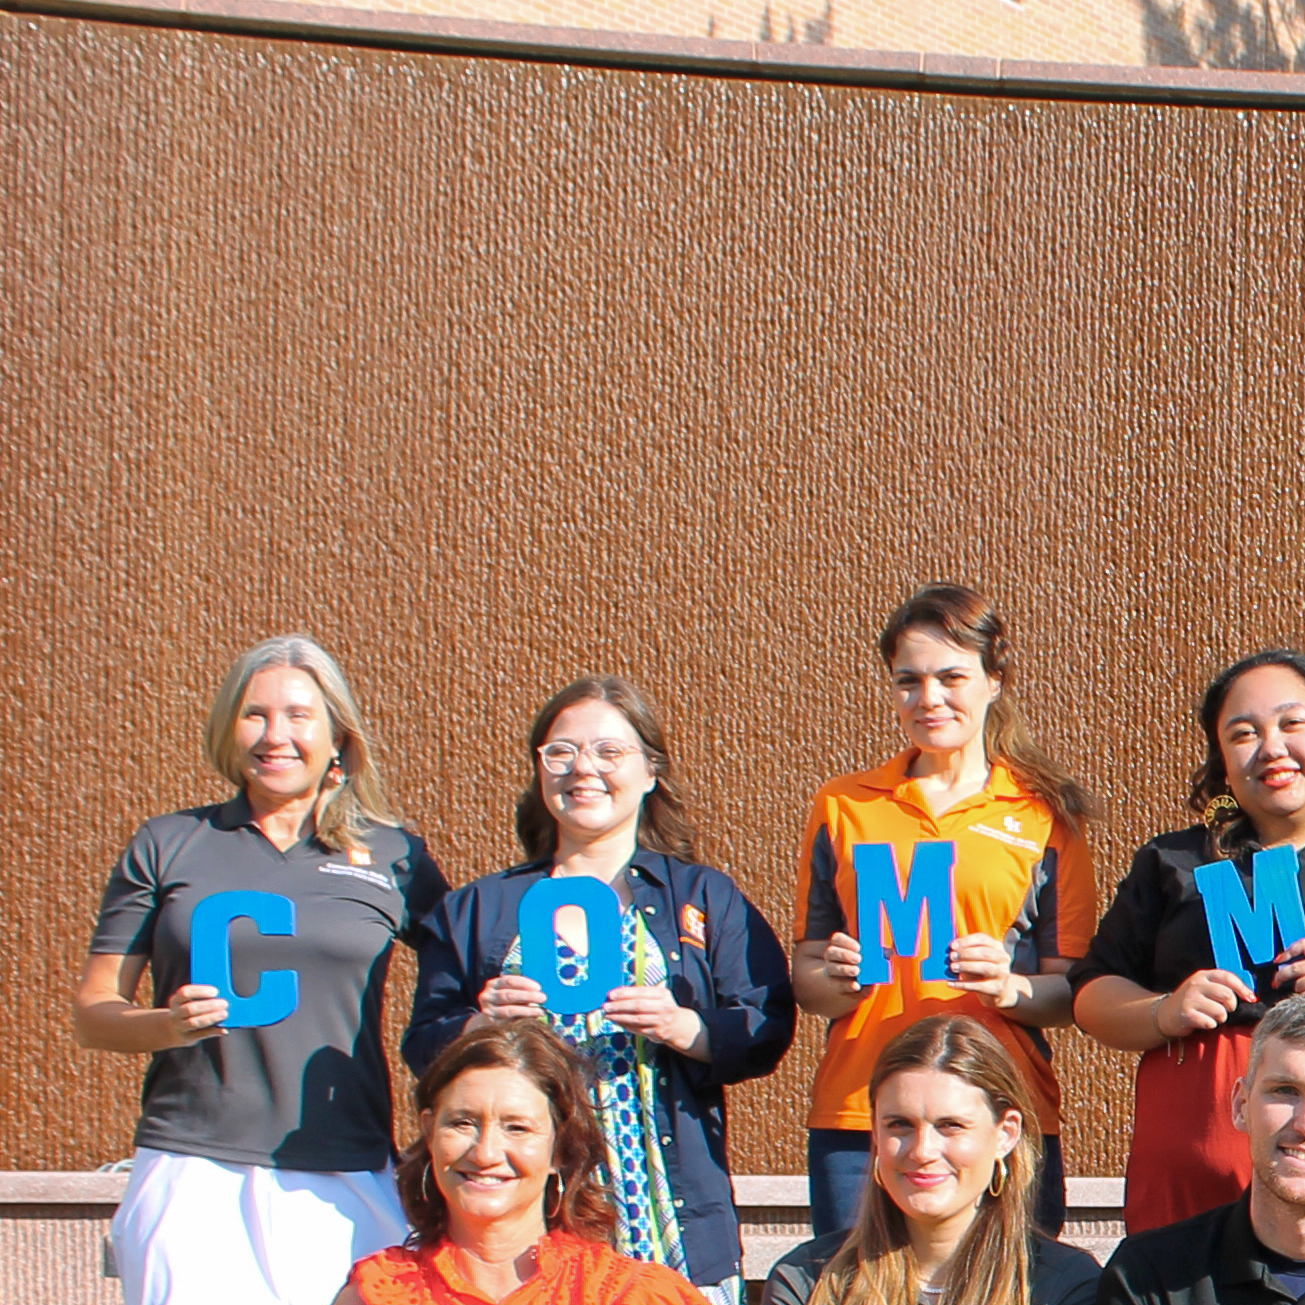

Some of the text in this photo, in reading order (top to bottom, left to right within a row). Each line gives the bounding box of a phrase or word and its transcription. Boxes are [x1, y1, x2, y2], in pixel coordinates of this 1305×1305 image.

[190, 890, 299, 1029] C
[518, 876, 625, 1014] O
[854, 841, 958, 985] M
